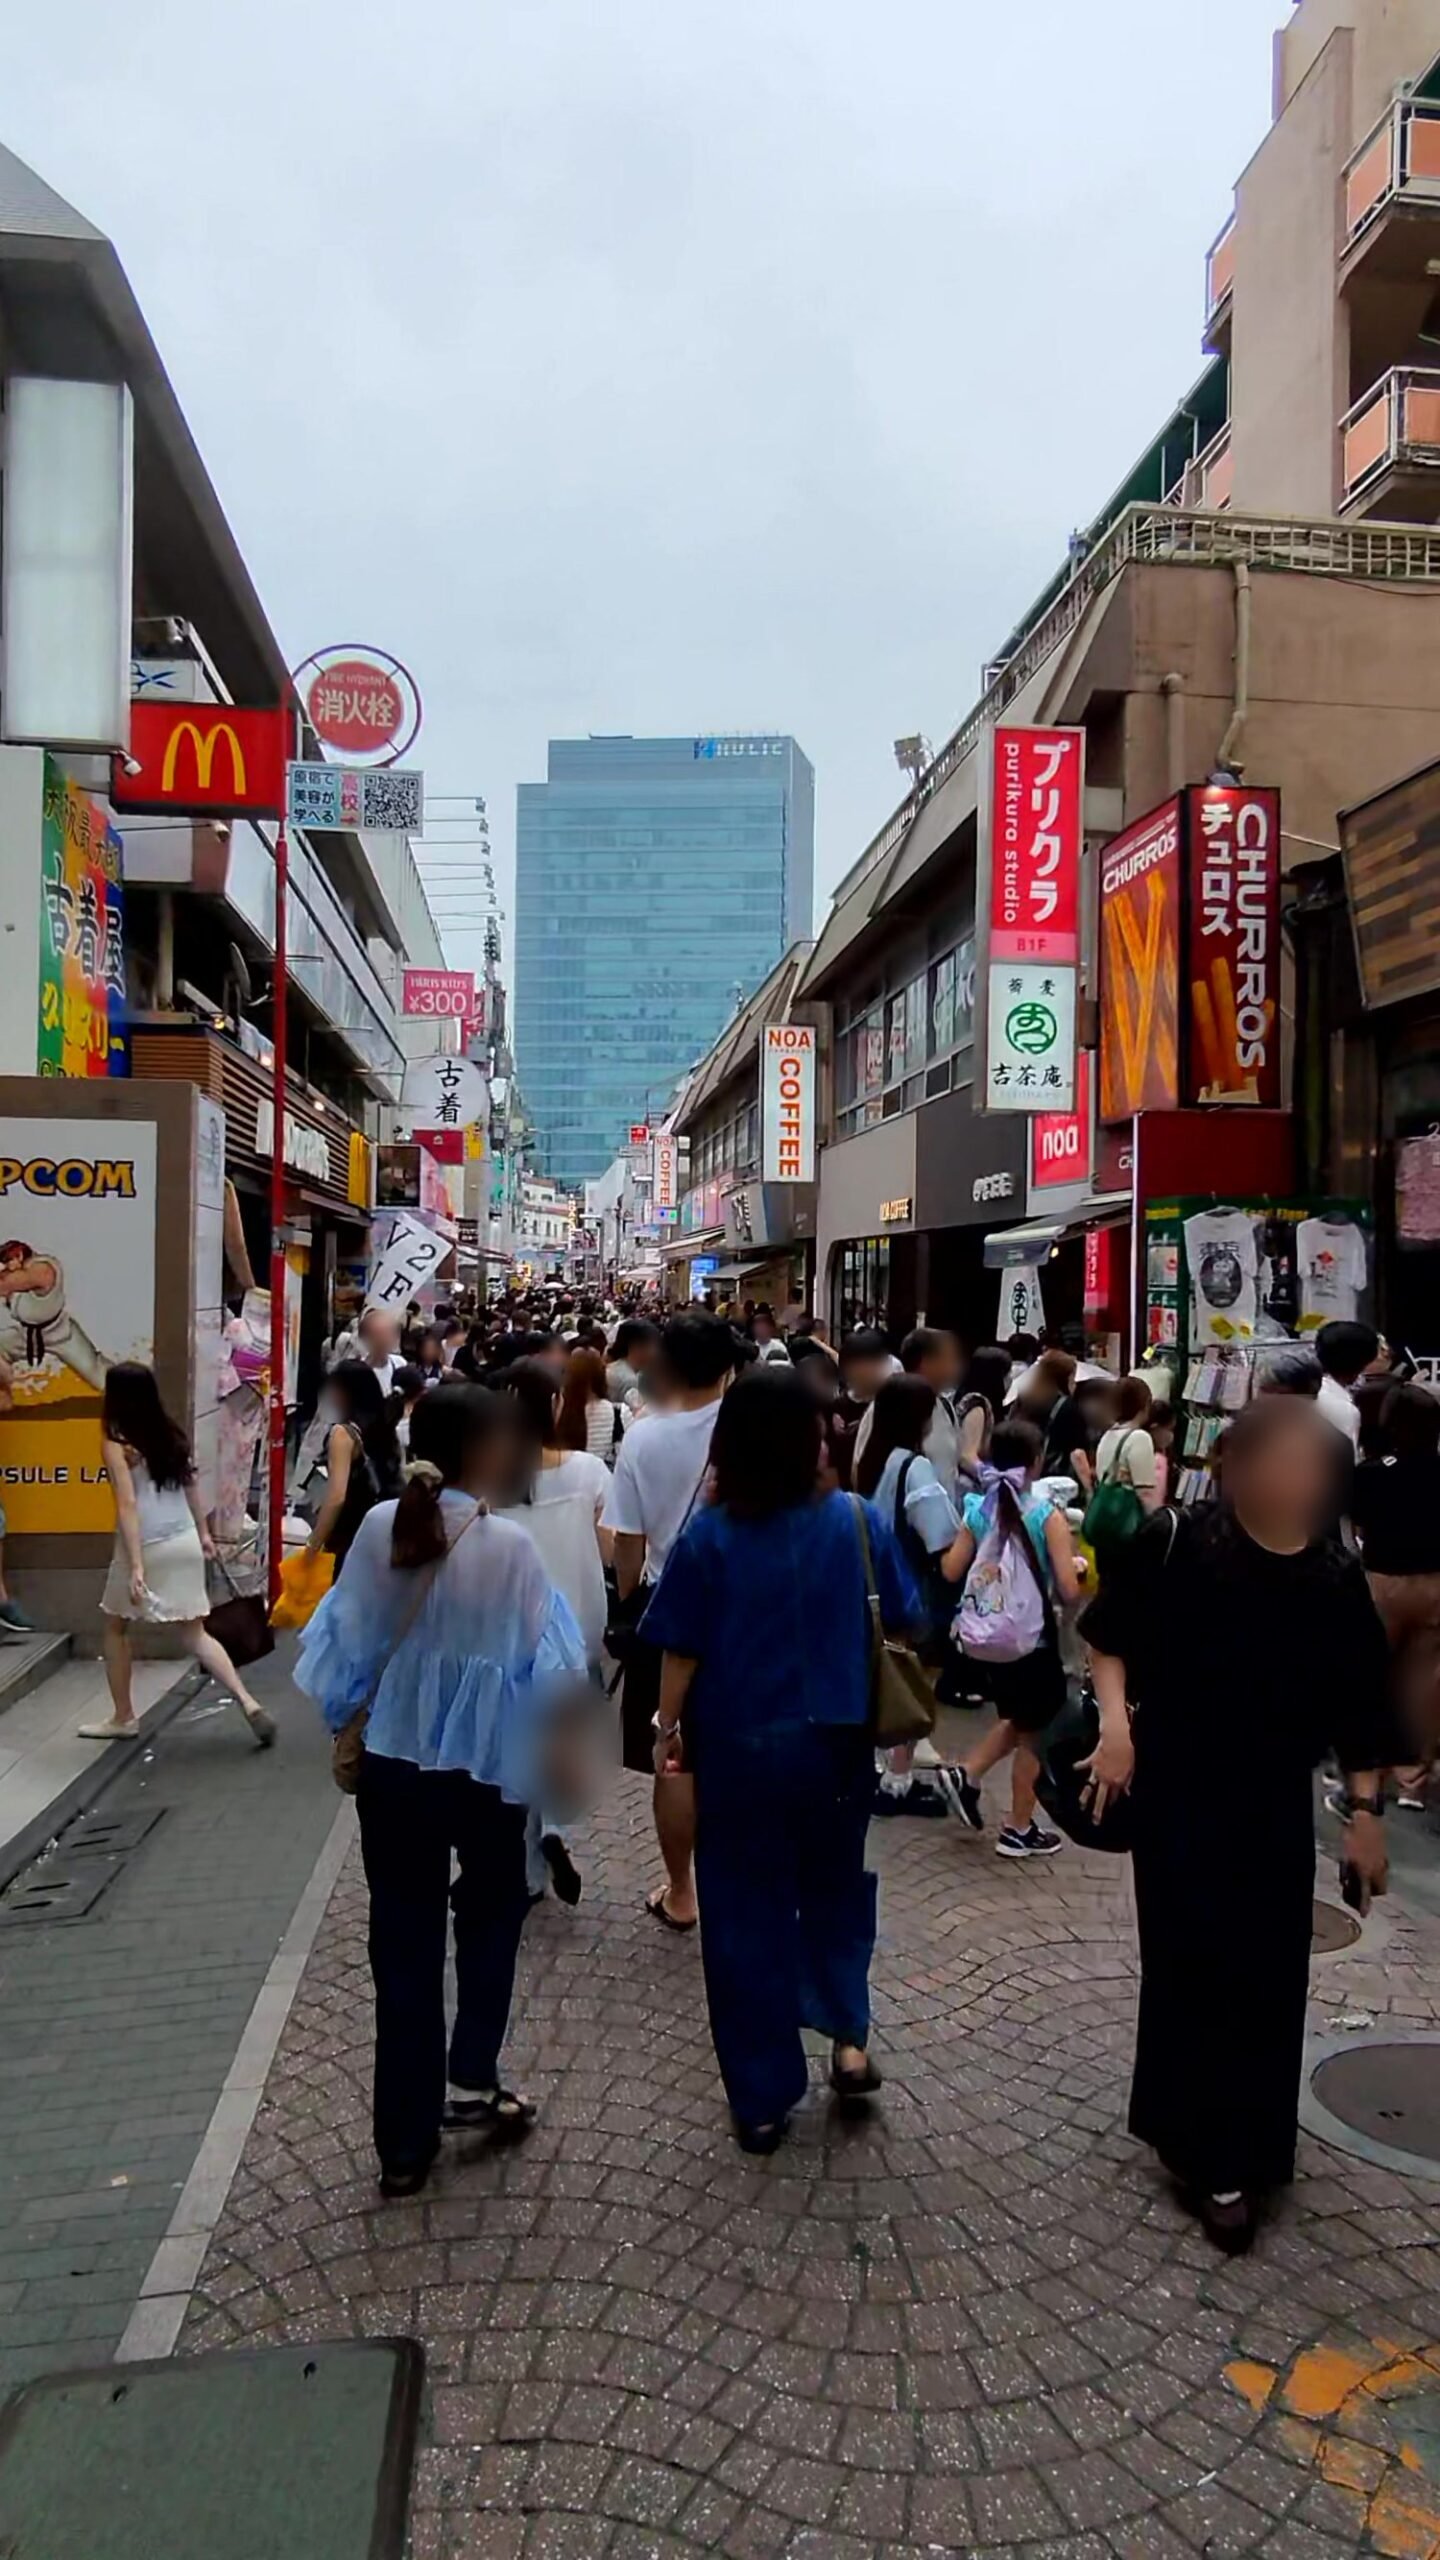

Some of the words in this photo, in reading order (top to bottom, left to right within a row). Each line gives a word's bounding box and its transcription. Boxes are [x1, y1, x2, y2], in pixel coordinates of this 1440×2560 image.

[316, 686, 395, 727] 消火栓
[716, 743, 783, 757] HULIC
[1003, 742, 1023, 842] purikura
[1028, 740, 1072, 924] プリクラ
[1102, 825, 1178, 894] CHURROS
[1003, 849, 1021, 923] studio
[1201, 802, 1233, 937] チュロス
[43, 850, 127, 999] 古着屋
[1017, 938, 1047, 953] B1F
[1236, 803, 1268, 1068] CHURROS
[408, 990, 468, 1015] ¥300
[768, 1031, 811, 1048] NOA
[434, 1060, 464, 1124] 古着
[779, 1058, 802, 1177] COFFEE
[1042, 1124, 1078, 1160] noa
[660, 1150, 671, 1206] COFFEE
[0, 1466, 68, 1484] SULE
